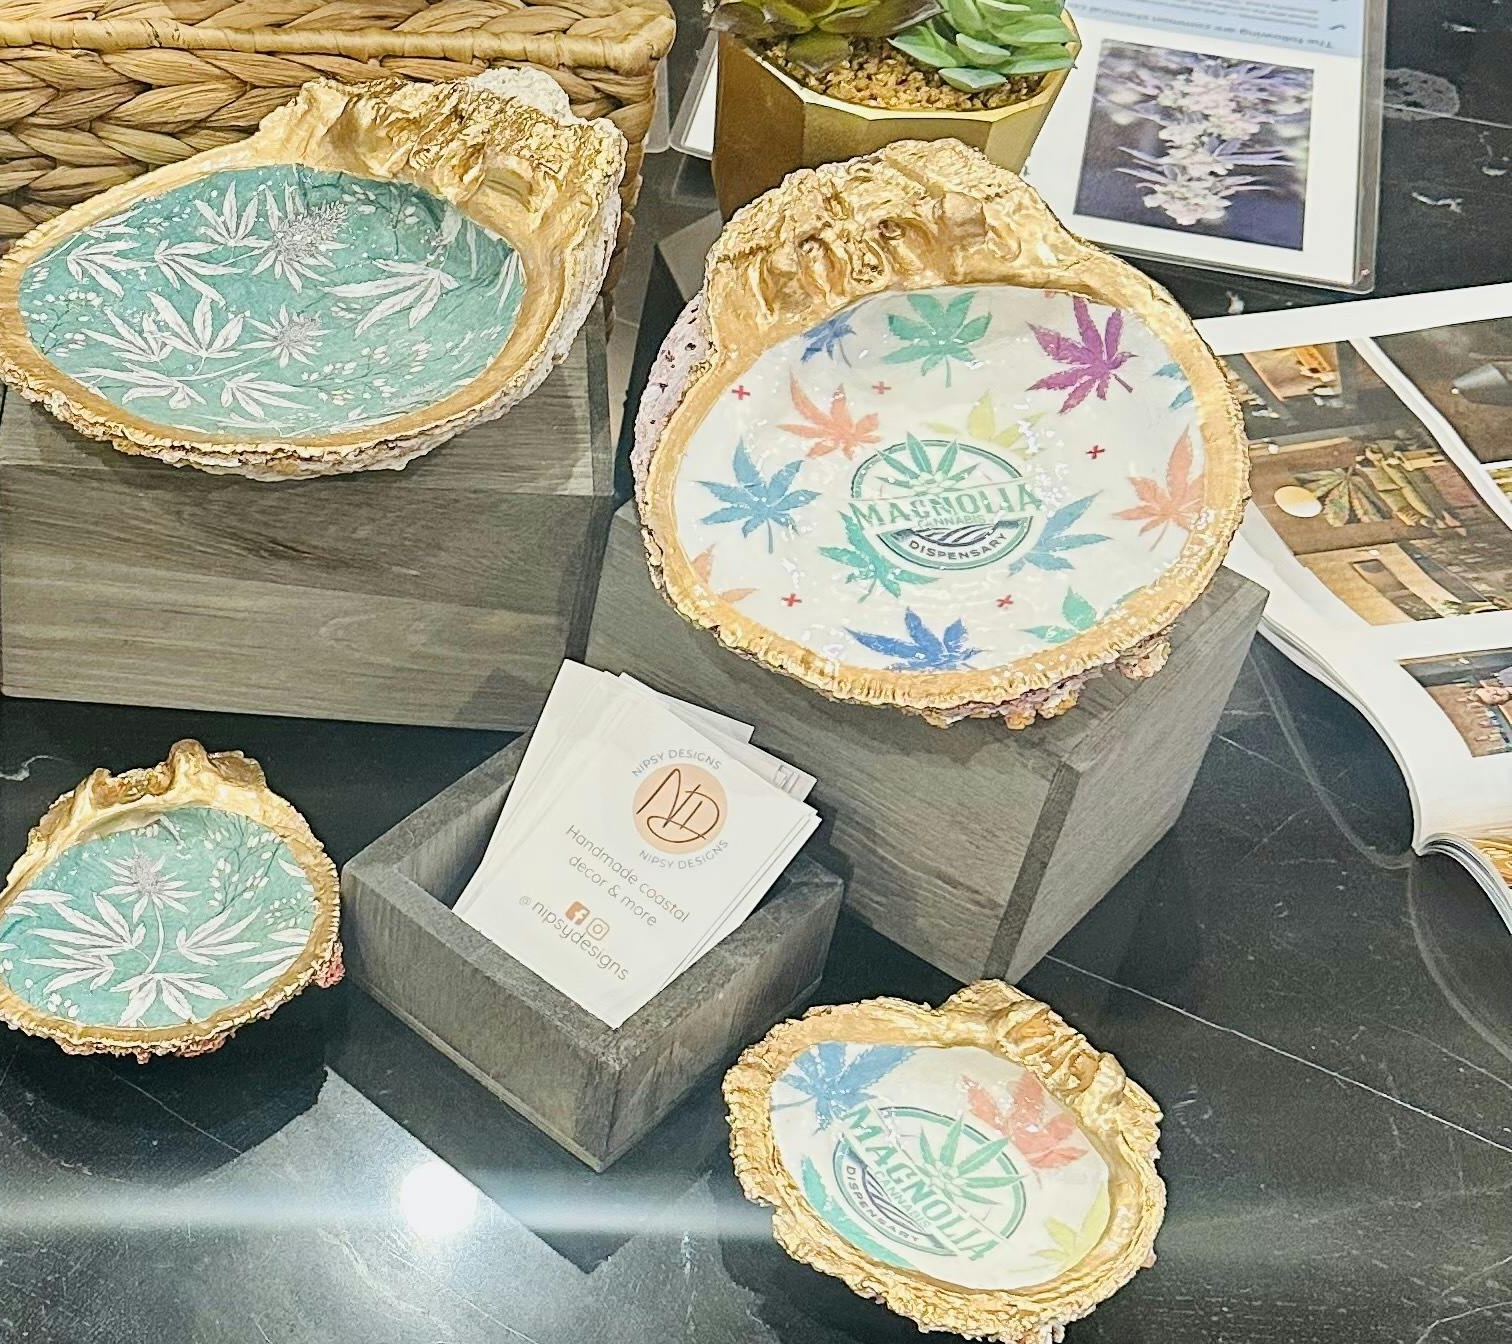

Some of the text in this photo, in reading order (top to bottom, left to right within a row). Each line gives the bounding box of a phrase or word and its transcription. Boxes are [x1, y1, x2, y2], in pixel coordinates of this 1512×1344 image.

[848, 483, 1043, 527] MAGNOLIA
[908, 531, 1009, 560] DISPENSARY
[632, 748, 722, 777] NIPSY DESIGNS
[566, 824, 690, 923] Handmade coastal
[639, 839, 728, 870] NIPSY DESIGNS
[568, 855, 657, 927] decor & more
[532, 901, 629, 981] nipsydesigns
[842, 1104, 1001, 1261] MAGNOLIA
[845, 1165, 920, 1243] DISPENSARY
